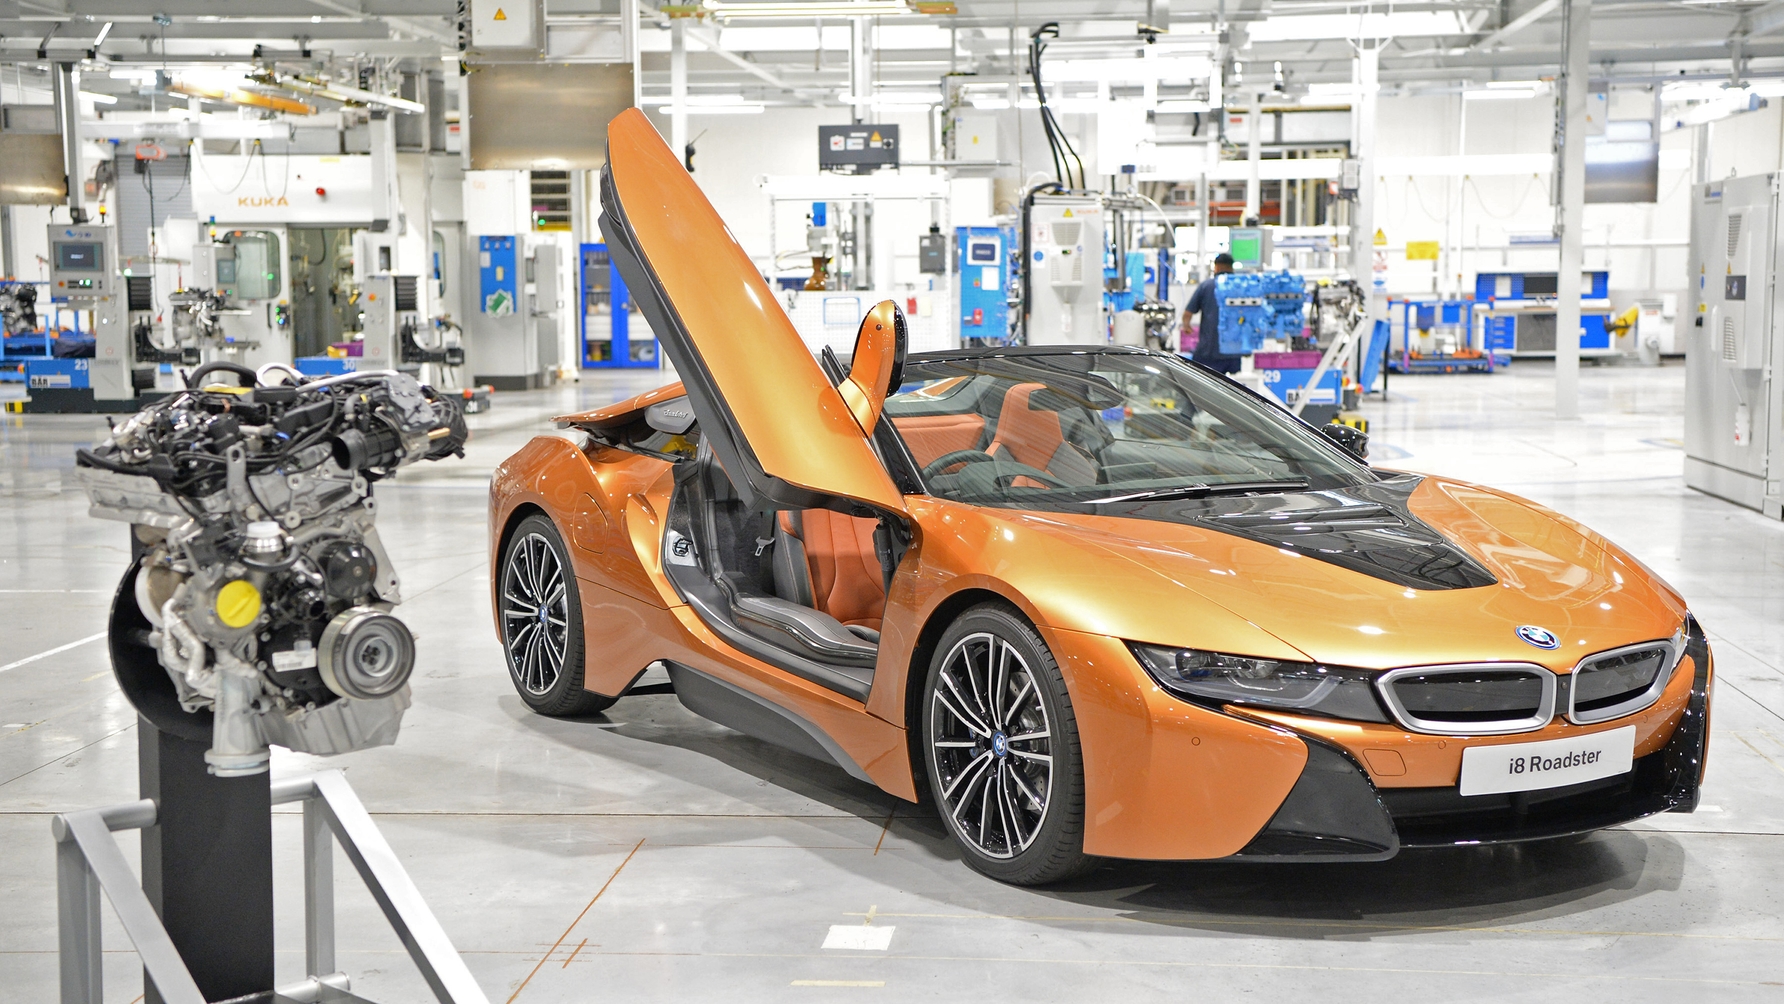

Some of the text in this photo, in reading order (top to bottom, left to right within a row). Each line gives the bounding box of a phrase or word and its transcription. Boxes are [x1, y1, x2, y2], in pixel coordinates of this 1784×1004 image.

[238, 197, 289, 207] KUKA
[74, 359, 88, 371] 23
[342, 359, 357, 371] 30
[1264, 369, 1282, 383] 29
[1509, 750, 1602, 775] i8 Roadster
